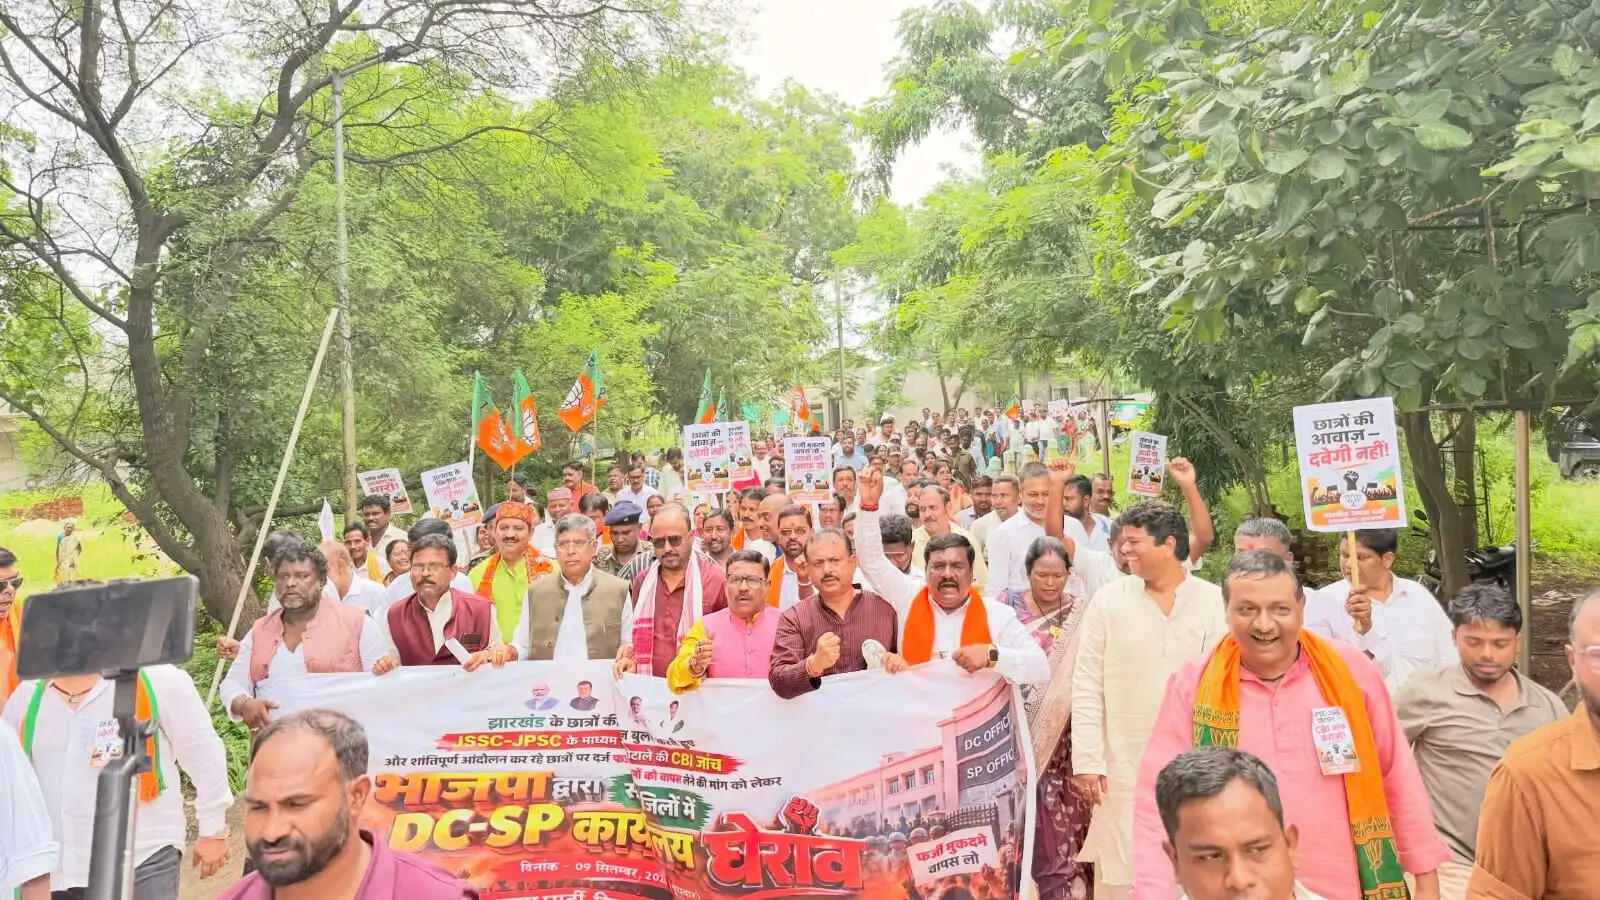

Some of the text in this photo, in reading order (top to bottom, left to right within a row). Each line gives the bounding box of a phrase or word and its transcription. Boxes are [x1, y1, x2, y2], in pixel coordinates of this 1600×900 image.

[1313, 411, 1374, 431] छात्रों की
[711, 428, 721, 437] की
[1312, 429, 1365, 446] आवाज़
[1355, 440, 1390, 461] नहीं!
[487, 713, 546, 730] झारखंड
[549, 713, 564, 727] के
[567, 714, 600, 728] छात्रों
[453, 734, 562, 748] JSSC-JPSC
[566, 735, 578, 745] के
[581, 735, 618, 745] माध्यम
[964, 735, 982, 751] DC
[385, 754, 408, 767] और
[411, 753, 459, 768] शांतिपूर्ण
[461, 753, 507, 765] आंदोलन
[510, 754, 528, 764] कर
[530, 752, 545, 764] रहे
[546, 751, 574, 764] छात्रों
[576, 753, 591, 762] पर
[593, 751, 611, 763] दर्ज
[655, 750, 669, 763] की
[671, 751, 693, 767] CBI
[695, 753, 722, 771] जांच
[644, 769, 658, 781] को
[660, 772, 682, 784] वापस
[683, 774, 695, 786] लेने
[696, 776, 707, 788] की
[709, 777, 728, 790] मांग
[730, 776, 748, 790] को
[749, 776, 783, 789] लेकर
[966, 766, 983, 780] SP
[375, 772, 554, 806] भाजपा
[551, 778, 602, 801] द्वारा
[641, 790, 680, 818] जिलों
[682, 795, 697, 820] में
[389, 803, 566, 853] DC-SP
[702, 811, 867, 889] घेराव
[916, 833, 988, 862] फर्जी मुकदमे
[520, 859, 560, 873] दिनांक
[575, 862, 592, 872] 09
[928, 850, 980, 874] वापस लो
